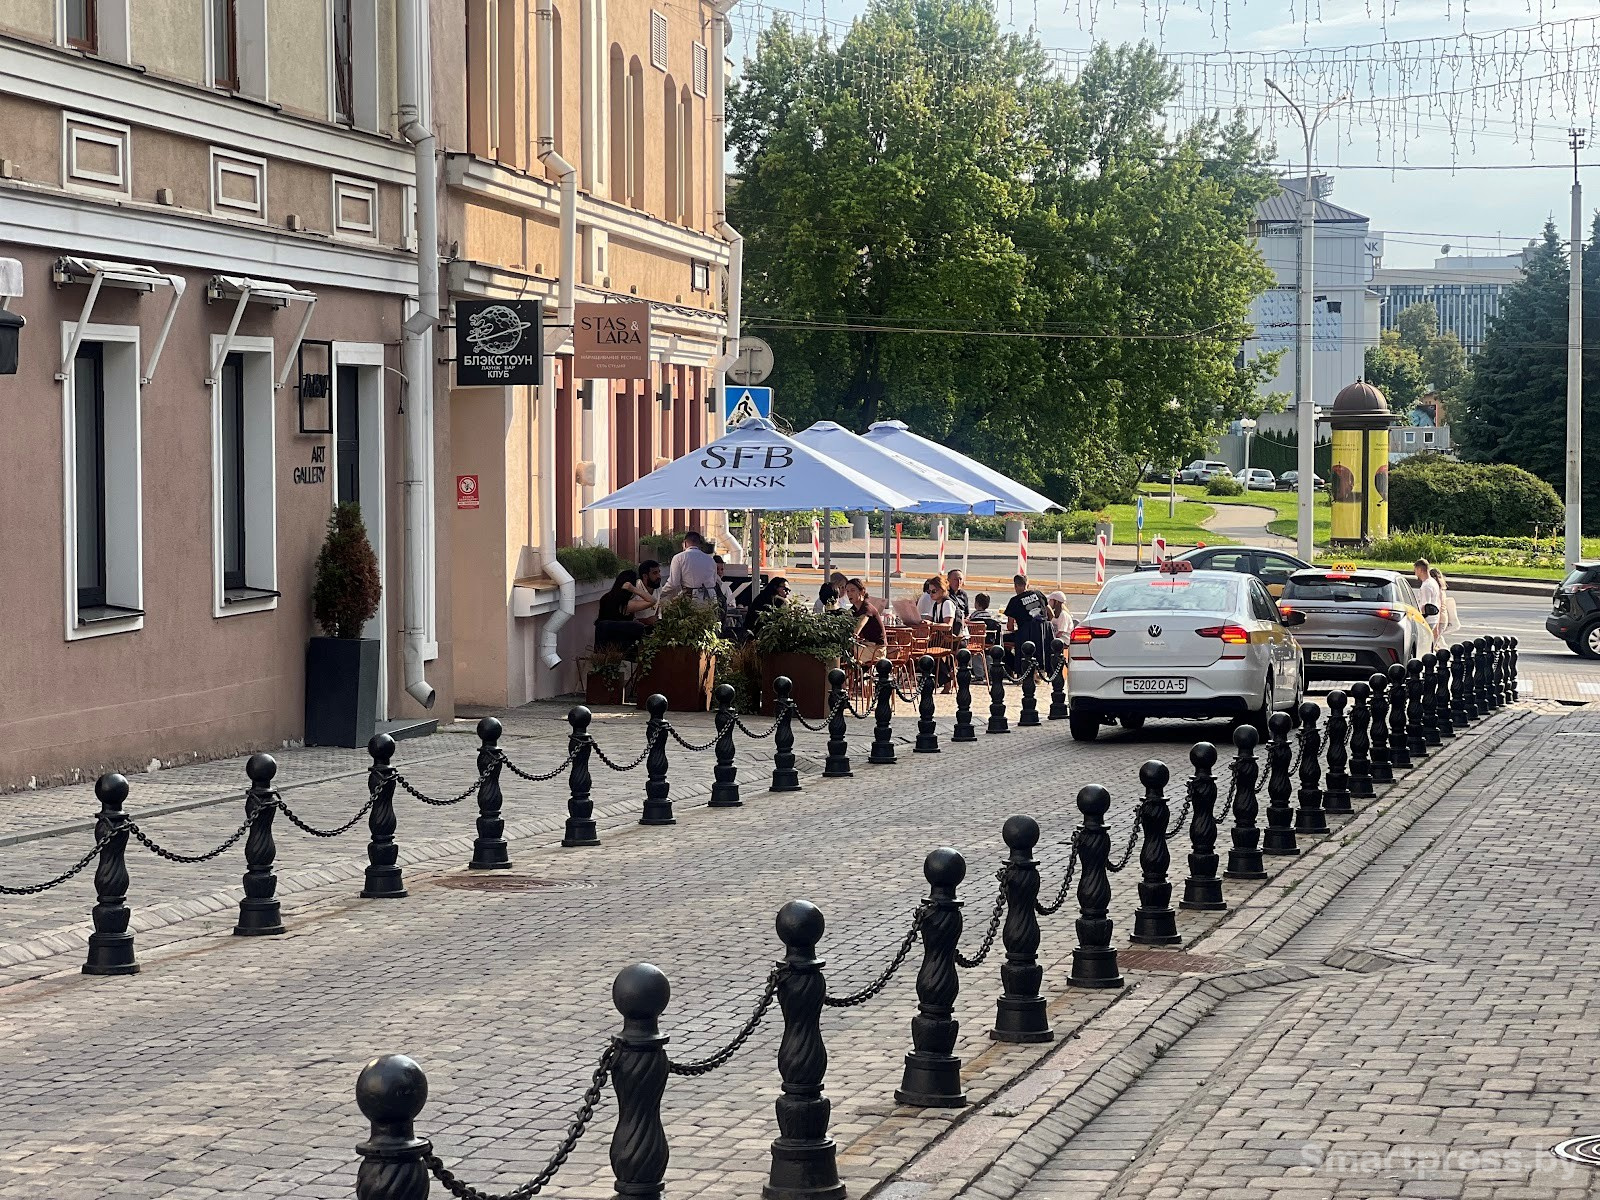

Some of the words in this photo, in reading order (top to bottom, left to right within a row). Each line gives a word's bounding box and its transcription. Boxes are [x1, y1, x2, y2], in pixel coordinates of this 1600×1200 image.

[581, 316, 627, 331] STAS
[630, 320, 640, 331] &
[597, 330, 642, 344] LARA
[463, 355, 533, 366] БЛЭКСТОУН
[487, 370, 510, 379] КЛУБ
[311, 446, 325, 463] ART
[700, 445, 794, 470] SFB
[293, 466, 326, 484] GALLERY
[693, 475, 786, 488] MINSK
[1133, 679, 1157, 690] 5202
